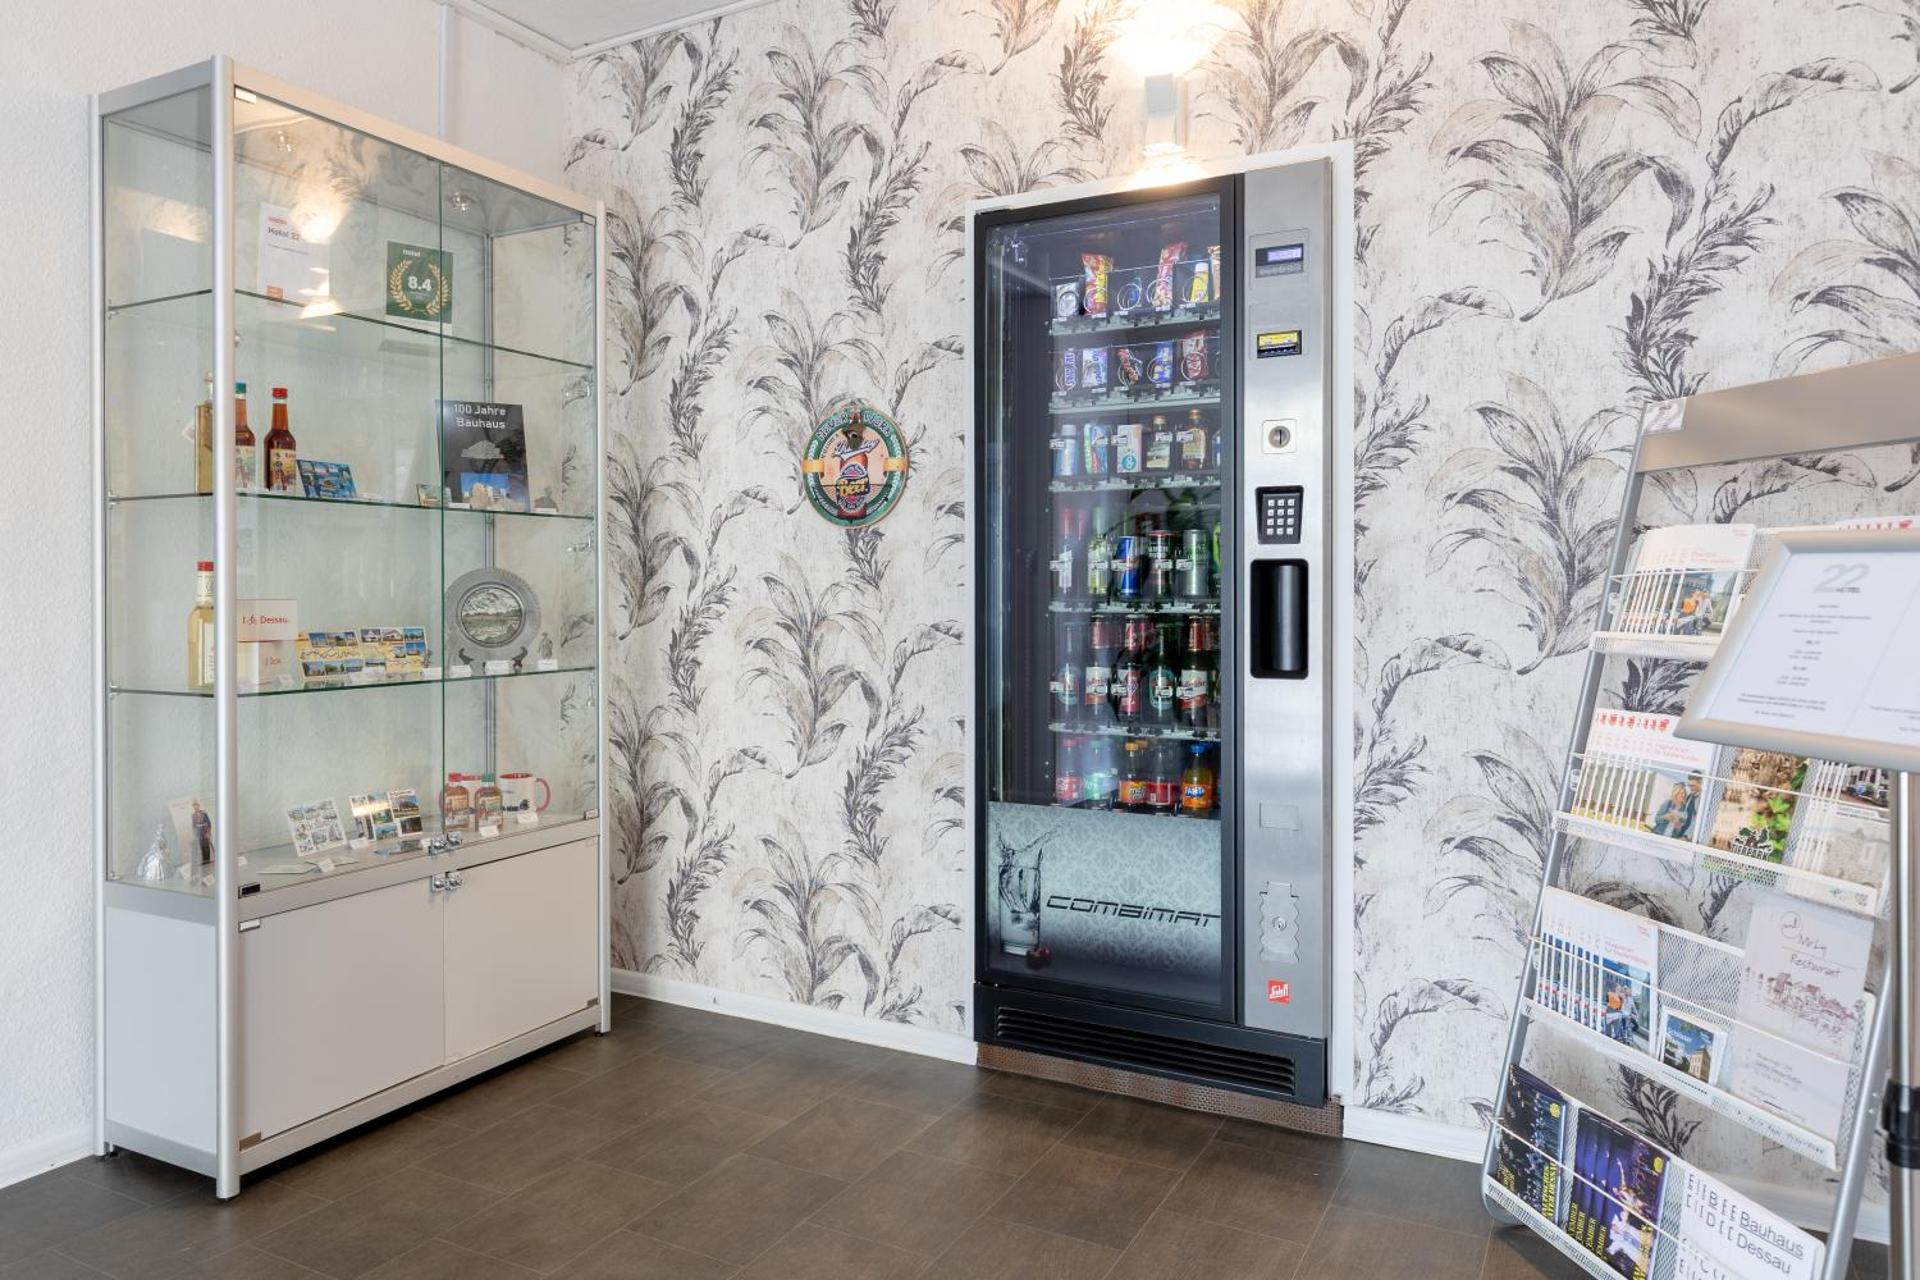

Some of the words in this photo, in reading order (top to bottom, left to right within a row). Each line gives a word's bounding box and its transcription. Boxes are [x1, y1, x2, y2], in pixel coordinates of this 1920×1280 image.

[407, 275, 432, 292] 8.4
[453, 403, 473, 414] 100
[474, 404, 507, 417] Jahre
[455, 416, 507, 430] Bauhaus
[1812, 562, 1871, 594] 22
[1739, 1210, 1804, 1257] Bauhaus
[1735, 1232, 1792, 1275] Dessau
